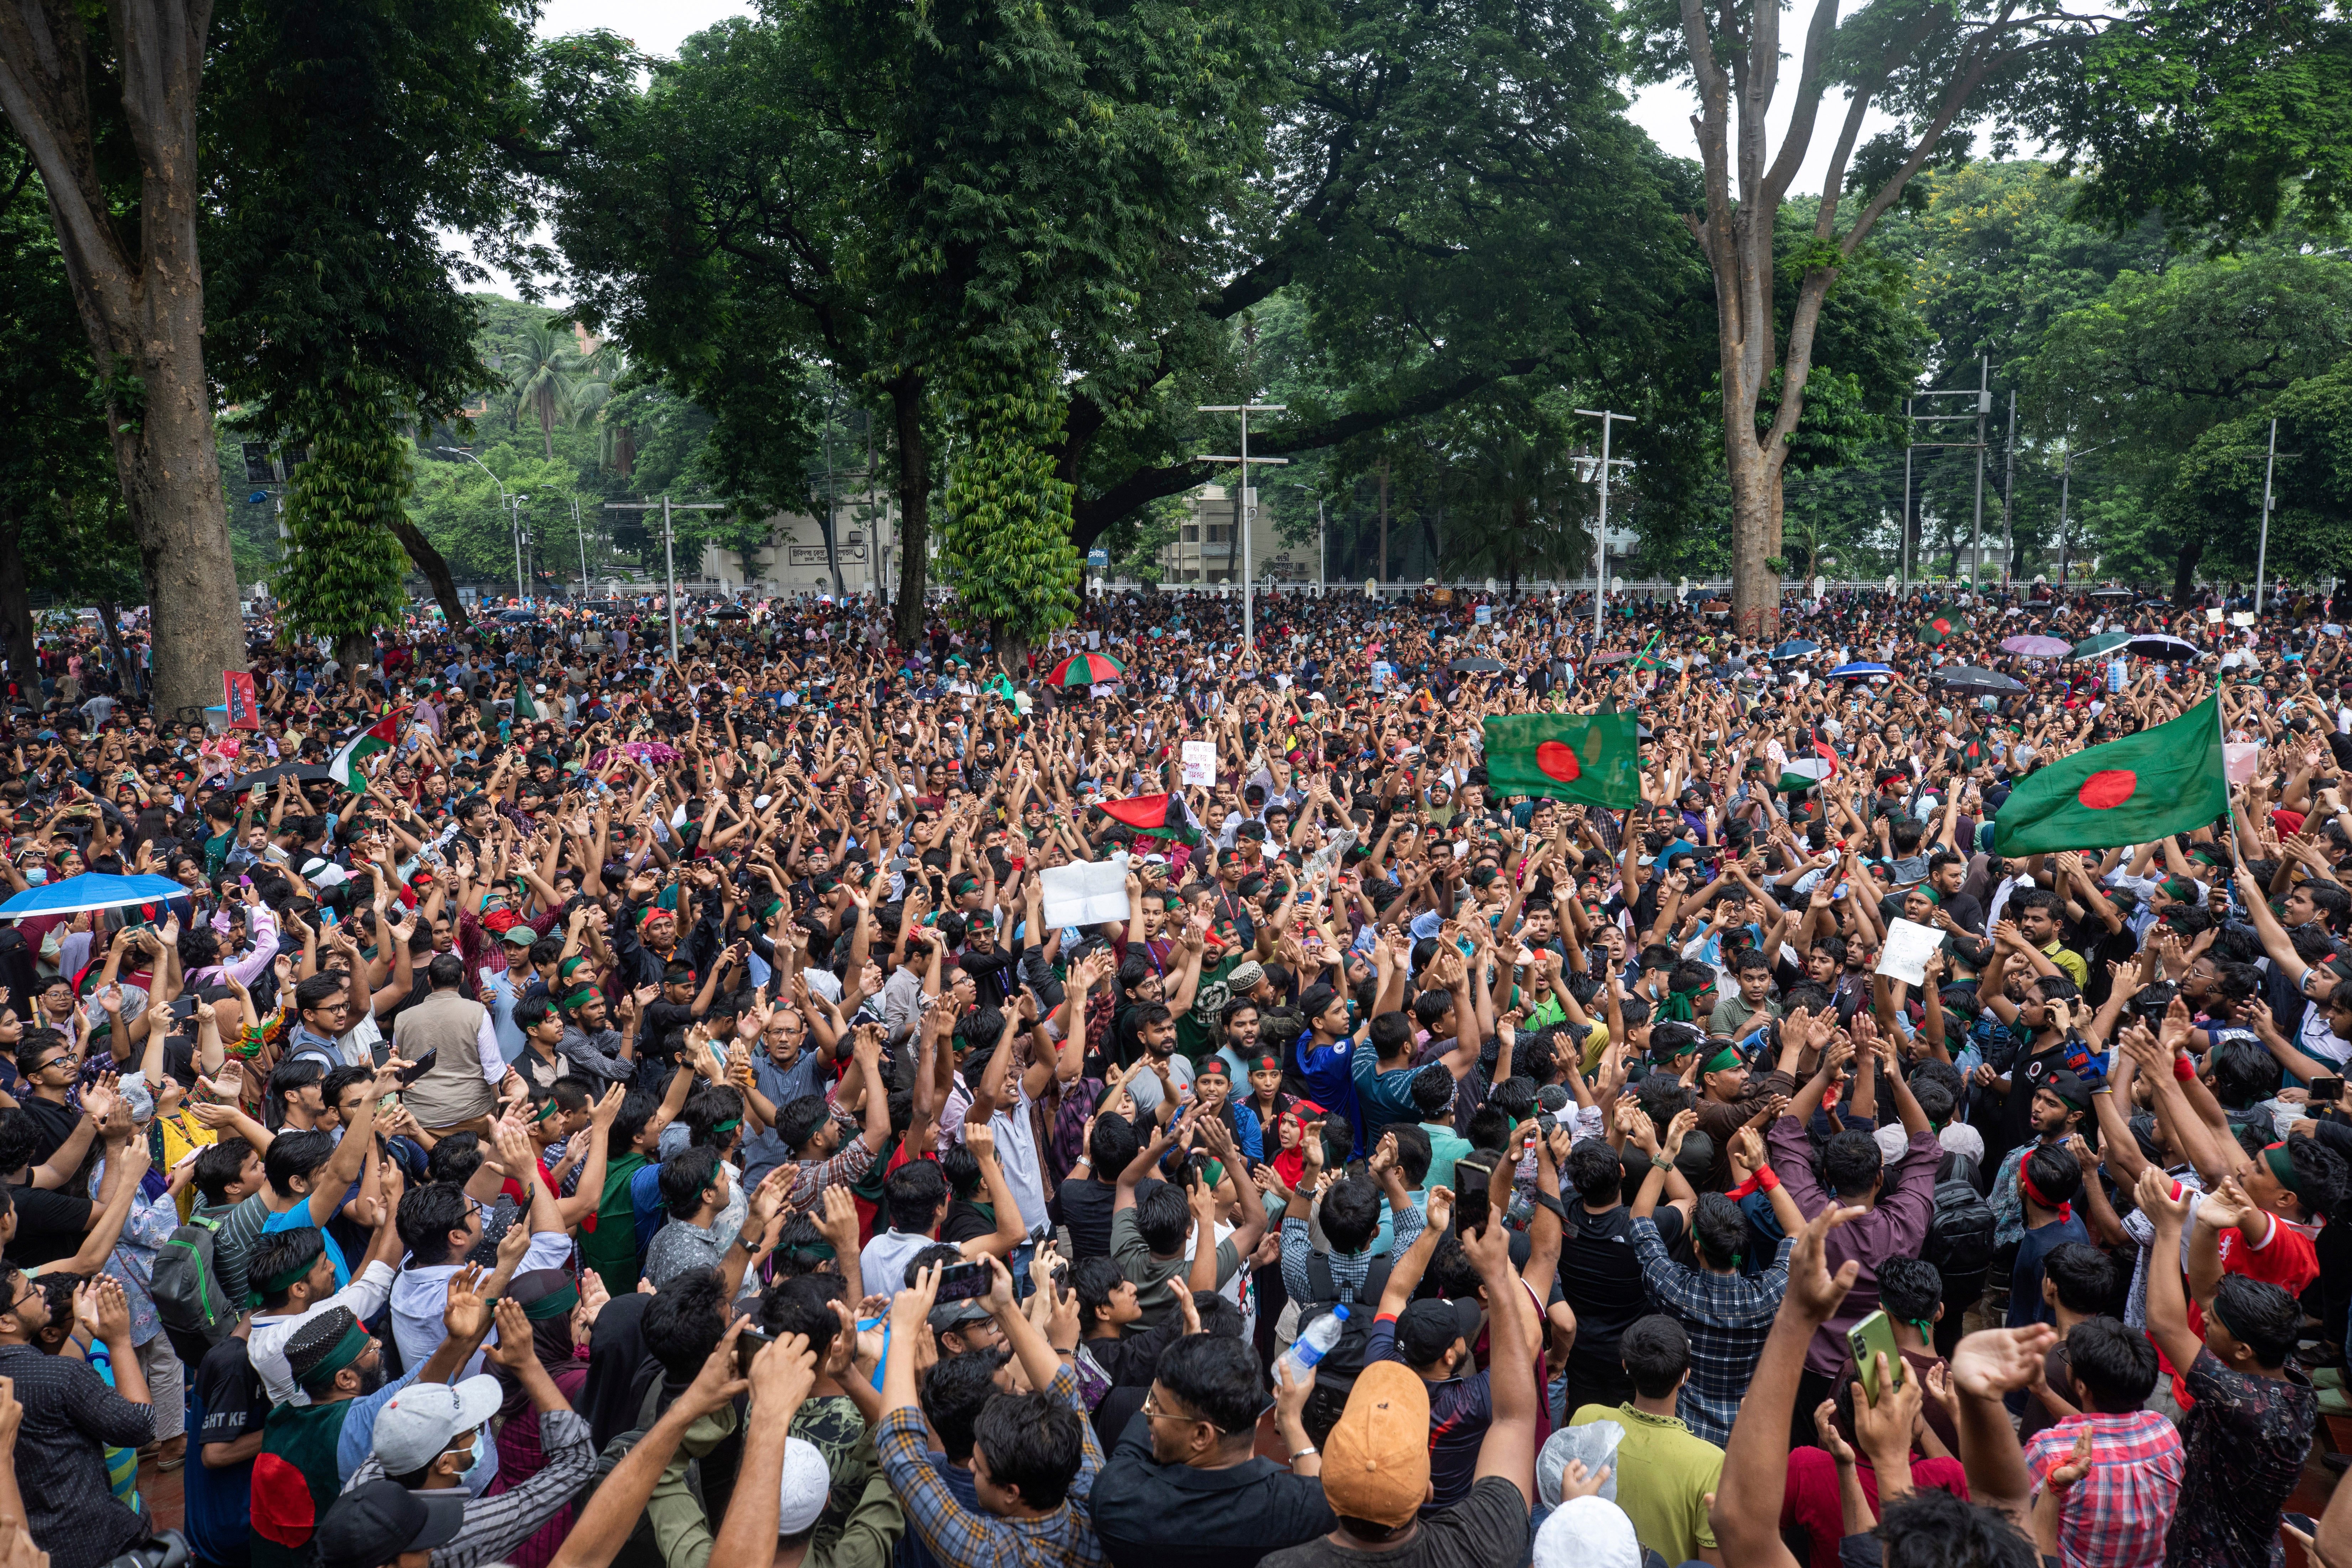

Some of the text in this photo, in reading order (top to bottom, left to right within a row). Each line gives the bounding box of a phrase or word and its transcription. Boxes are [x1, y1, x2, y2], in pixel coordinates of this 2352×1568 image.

[1089, 549, 1105, 558] সেন্টার
[1767, 743, 1779, 755] STOP
[2025, 1071, 2035, 1084] BATCH-24
